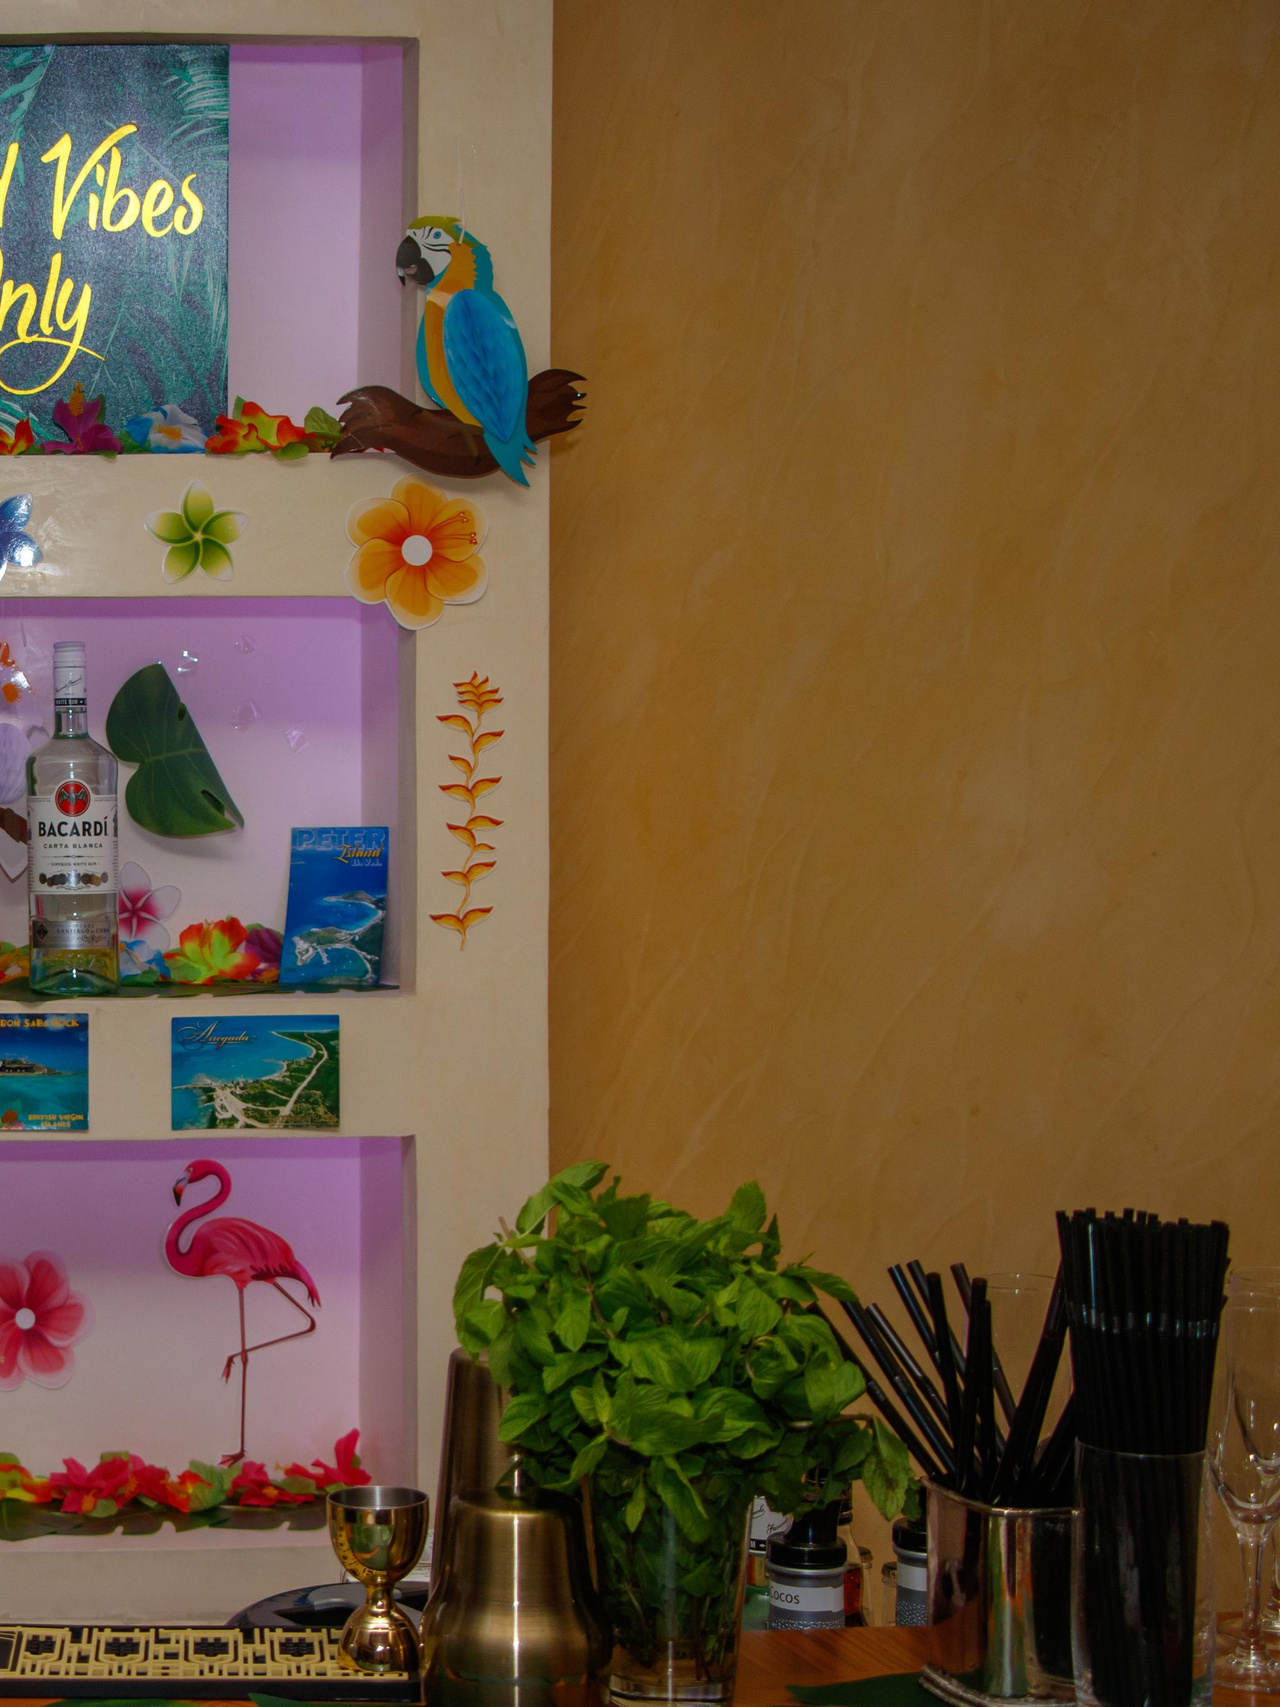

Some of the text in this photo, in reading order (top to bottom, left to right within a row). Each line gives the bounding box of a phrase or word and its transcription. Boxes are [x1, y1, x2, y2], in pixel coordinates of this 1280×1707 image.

[40, 123, 204, 240] Vibes
[38, 816, 109, 837] BACARDÍ
[297, 829, 386, 850] PETER
[331, 843, 384, 864] Island
[176, 1019, 257, 1050] Anegada
